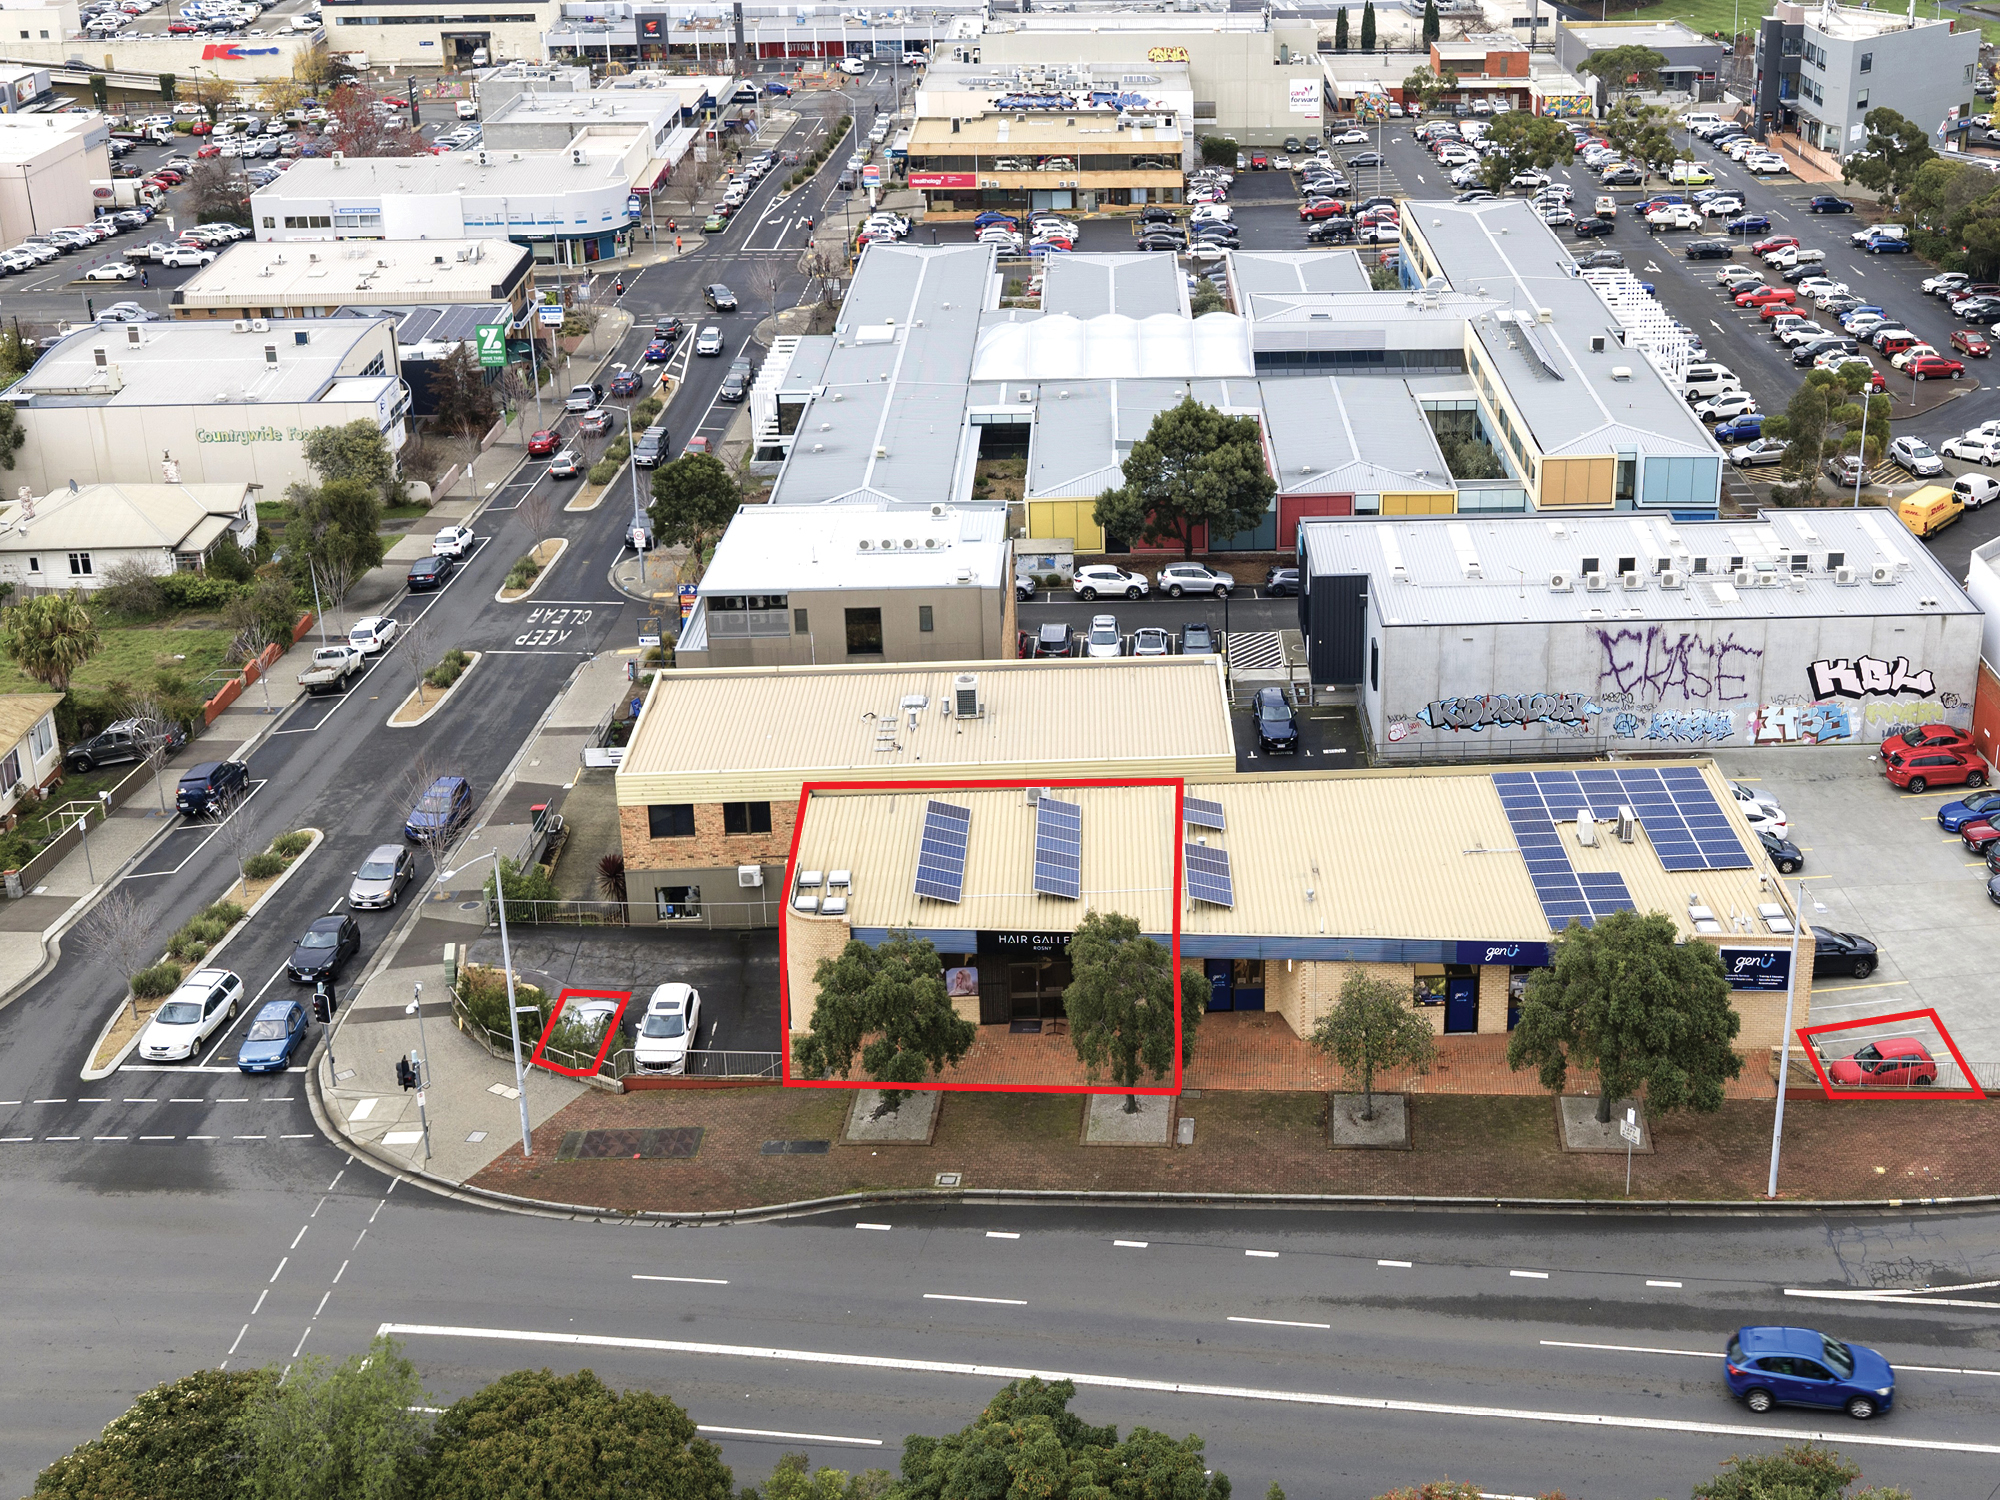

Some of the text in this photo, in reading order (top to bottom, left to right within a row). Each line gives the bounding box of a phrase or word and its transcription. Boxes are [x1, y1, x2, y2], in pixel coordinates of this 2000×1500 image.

[196, 426, 282, 445] Countrywide
[679, 585, 686, 593] P
[526, 607, 593, 625] CLEAR
[515, 629, 572, 645] KEEP
[998, 934, 1071, 944] HAIR GALLE
